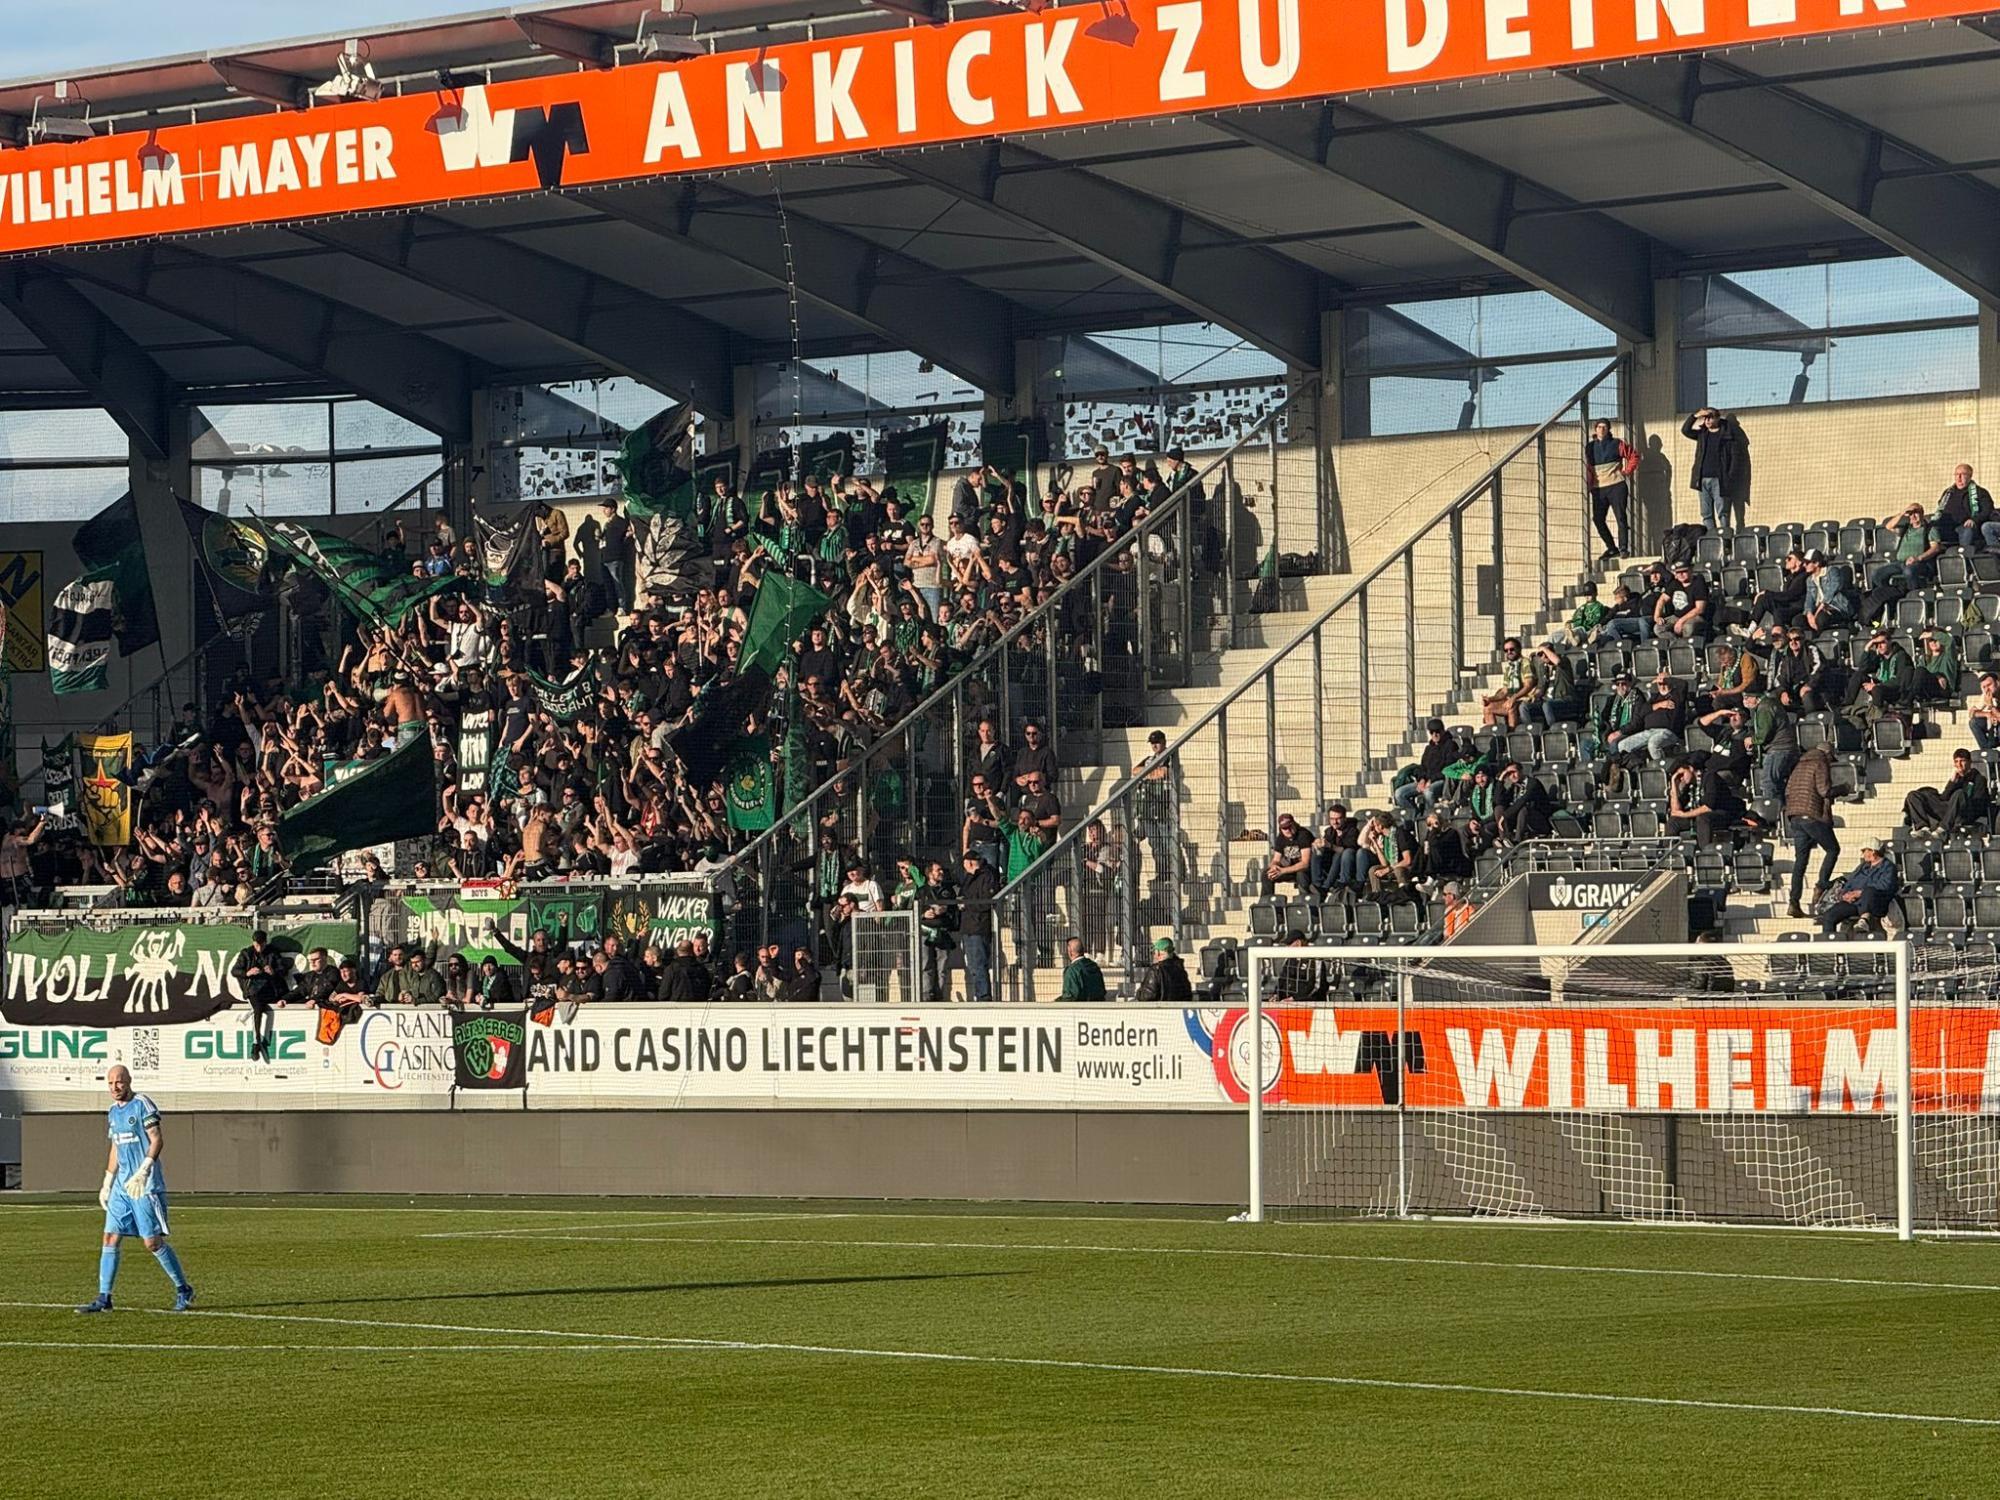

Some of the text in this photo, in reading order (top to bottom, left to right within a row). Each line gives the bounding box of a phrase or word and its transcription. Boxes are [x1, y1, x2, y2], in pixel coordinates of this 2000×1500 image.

[642, 17, 1084, 164] ANKICK
[1156, 0, 1300, 102] ZU
[218, 127, 396, 199] MAYER
[657, 895, 709, 924] WACKER
[6, 950, 119, 1003] IVOLI
[0, 1030, 108, 1059] GUNZ
[527, 1026, 1062, 1072] AND CASINO LIECHTENSTEIN
[1077, 1021, 1158, 1047] Bendern
[1077, 1056, 1183, 1086] www.gcli.li
[1445, 1027, 1898, 1112] WILHELM
